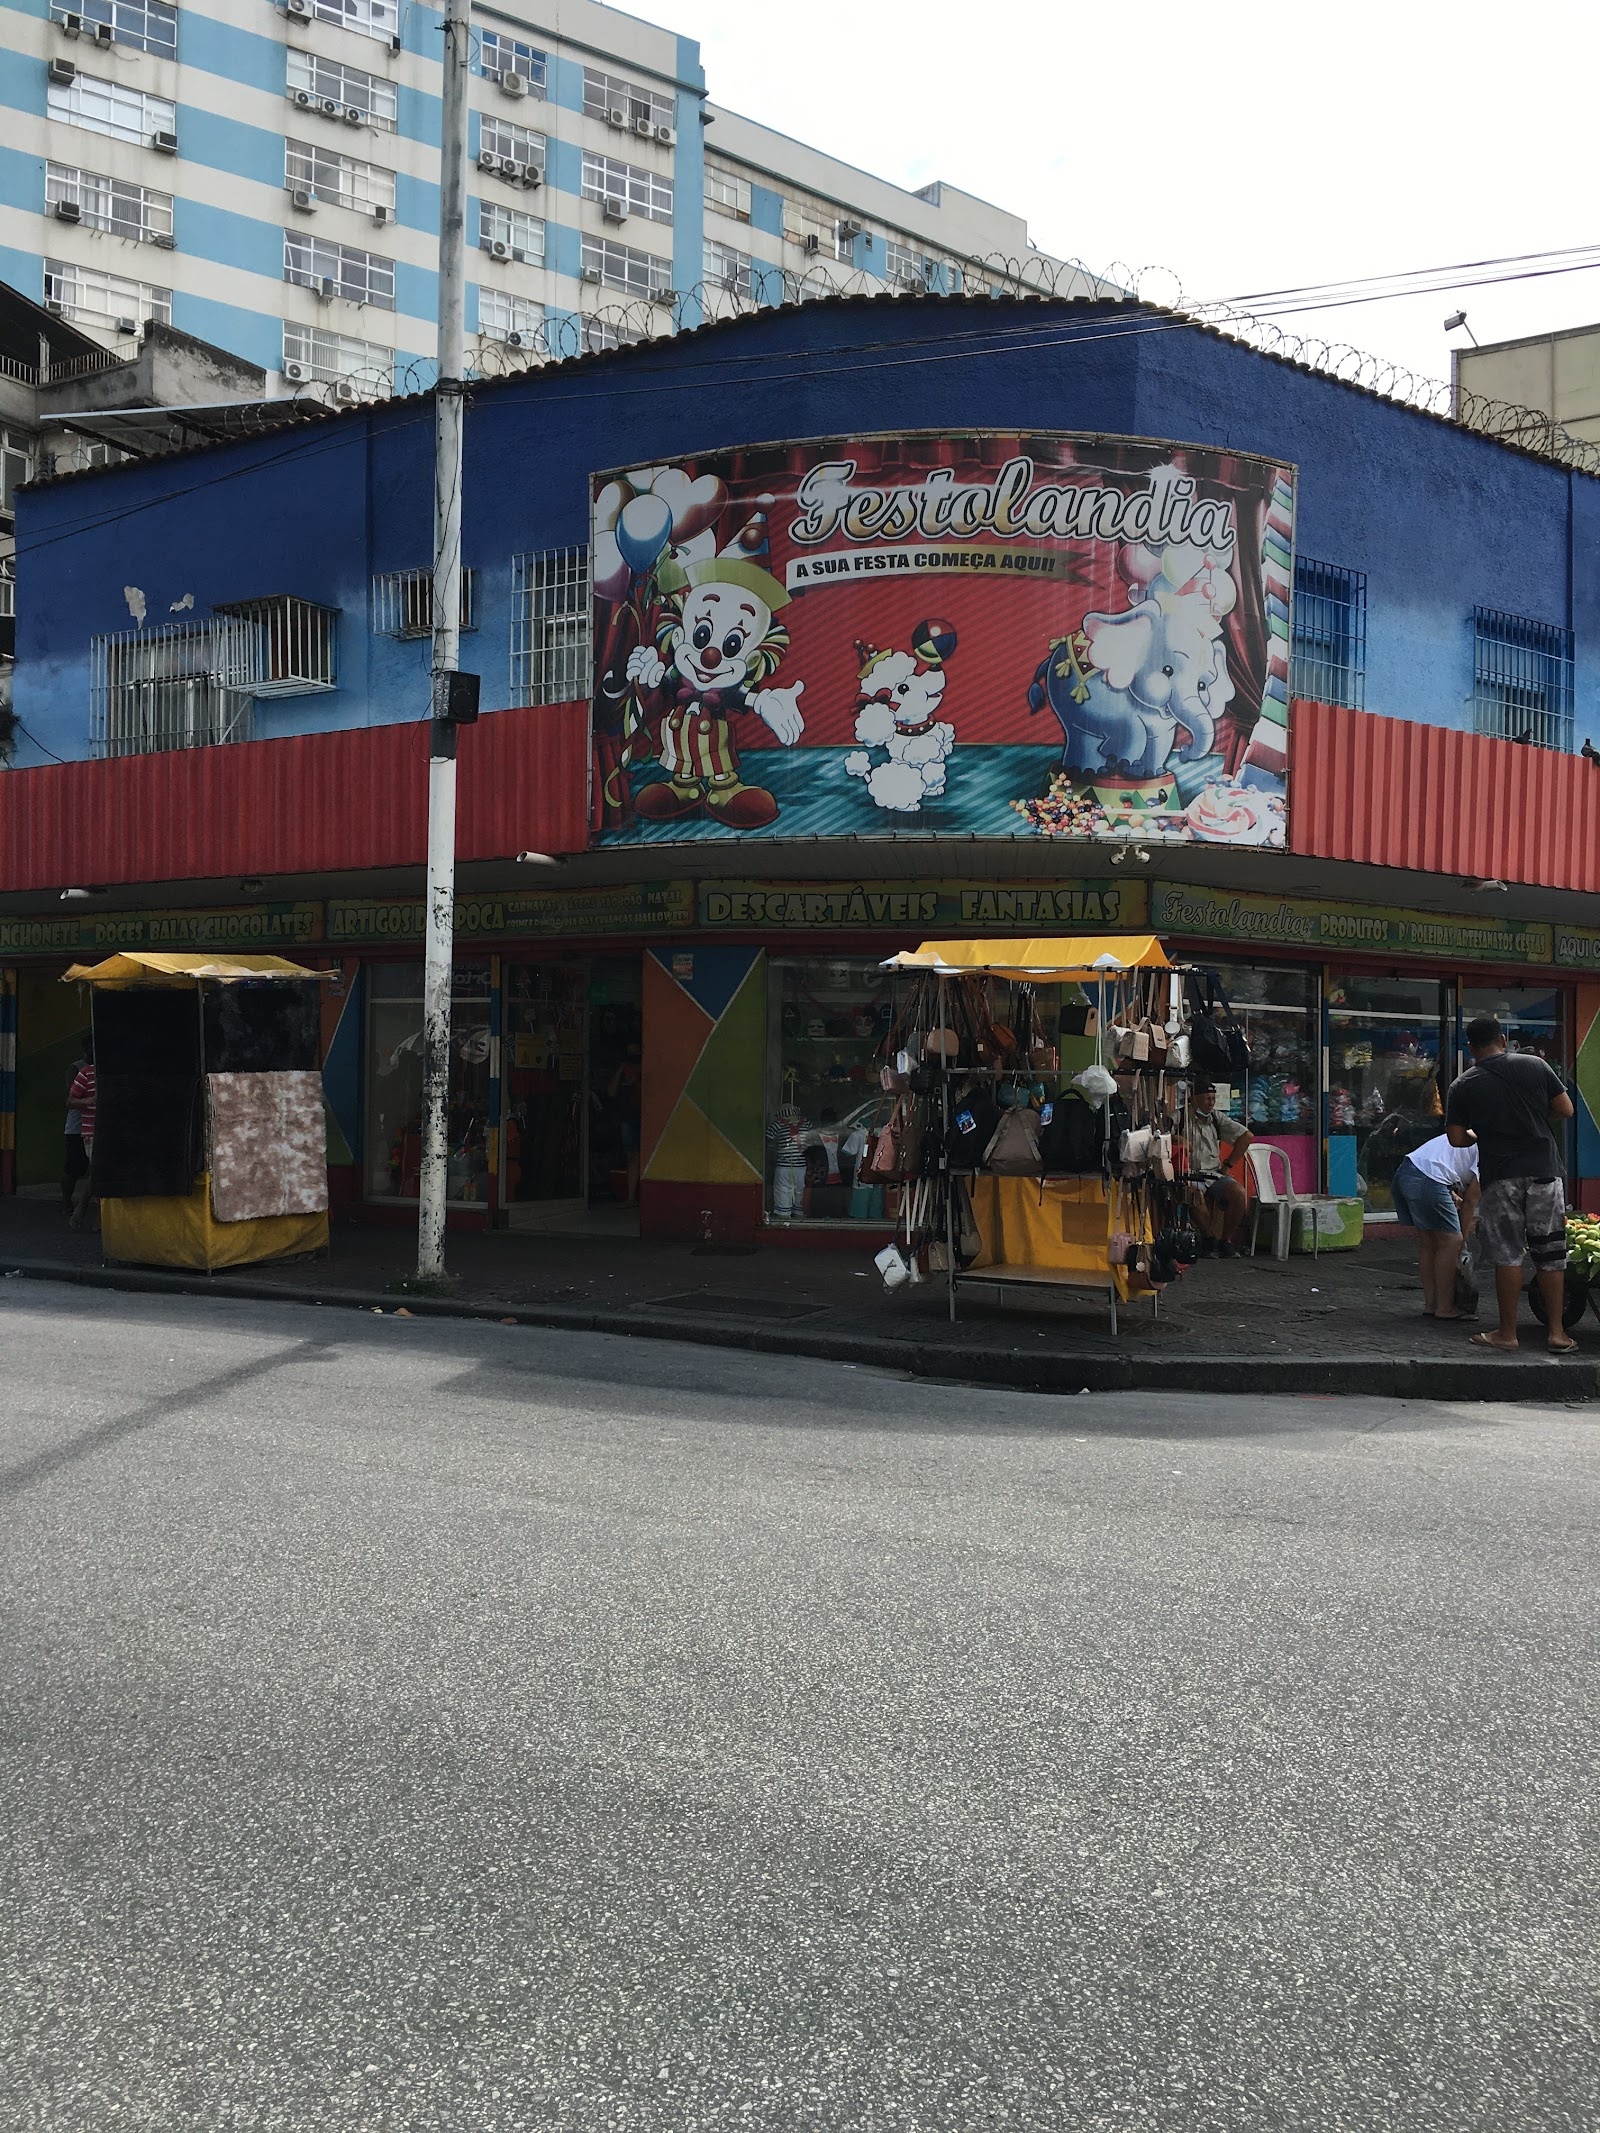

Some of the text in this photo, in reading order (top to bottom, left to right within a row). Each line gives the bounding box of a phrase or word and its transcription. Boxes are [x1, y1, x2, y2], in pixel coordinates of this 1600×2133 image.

[788, 456, 1237, 550] Festolandia
[796, 553, 1056, 578] A SUA FESTA COMEÇA AQUI!
[647, 890, 683, 904] NATAL
[706, 886, 1120, 923] DESCARTÁVEIS FANTASIAS
[1161, 890, 1309, 937] Festolandia
[95, 920, 143, 944] DOCES
[149, 917, 198, 942] BALAS
[203, 912, 314, 940] CHOCOLATES
[332, 905, 411, 936] ARTIGOS
[453, 902, 505, 931] POCA
[635, 910, 689, 922] HALLOWEEN
[1320, 914, 1546, 955] PRODUTOS P/ BOLEIRAS ARTESANATOS CESTAS
[1559, 936, 1589, 959] AQUI
